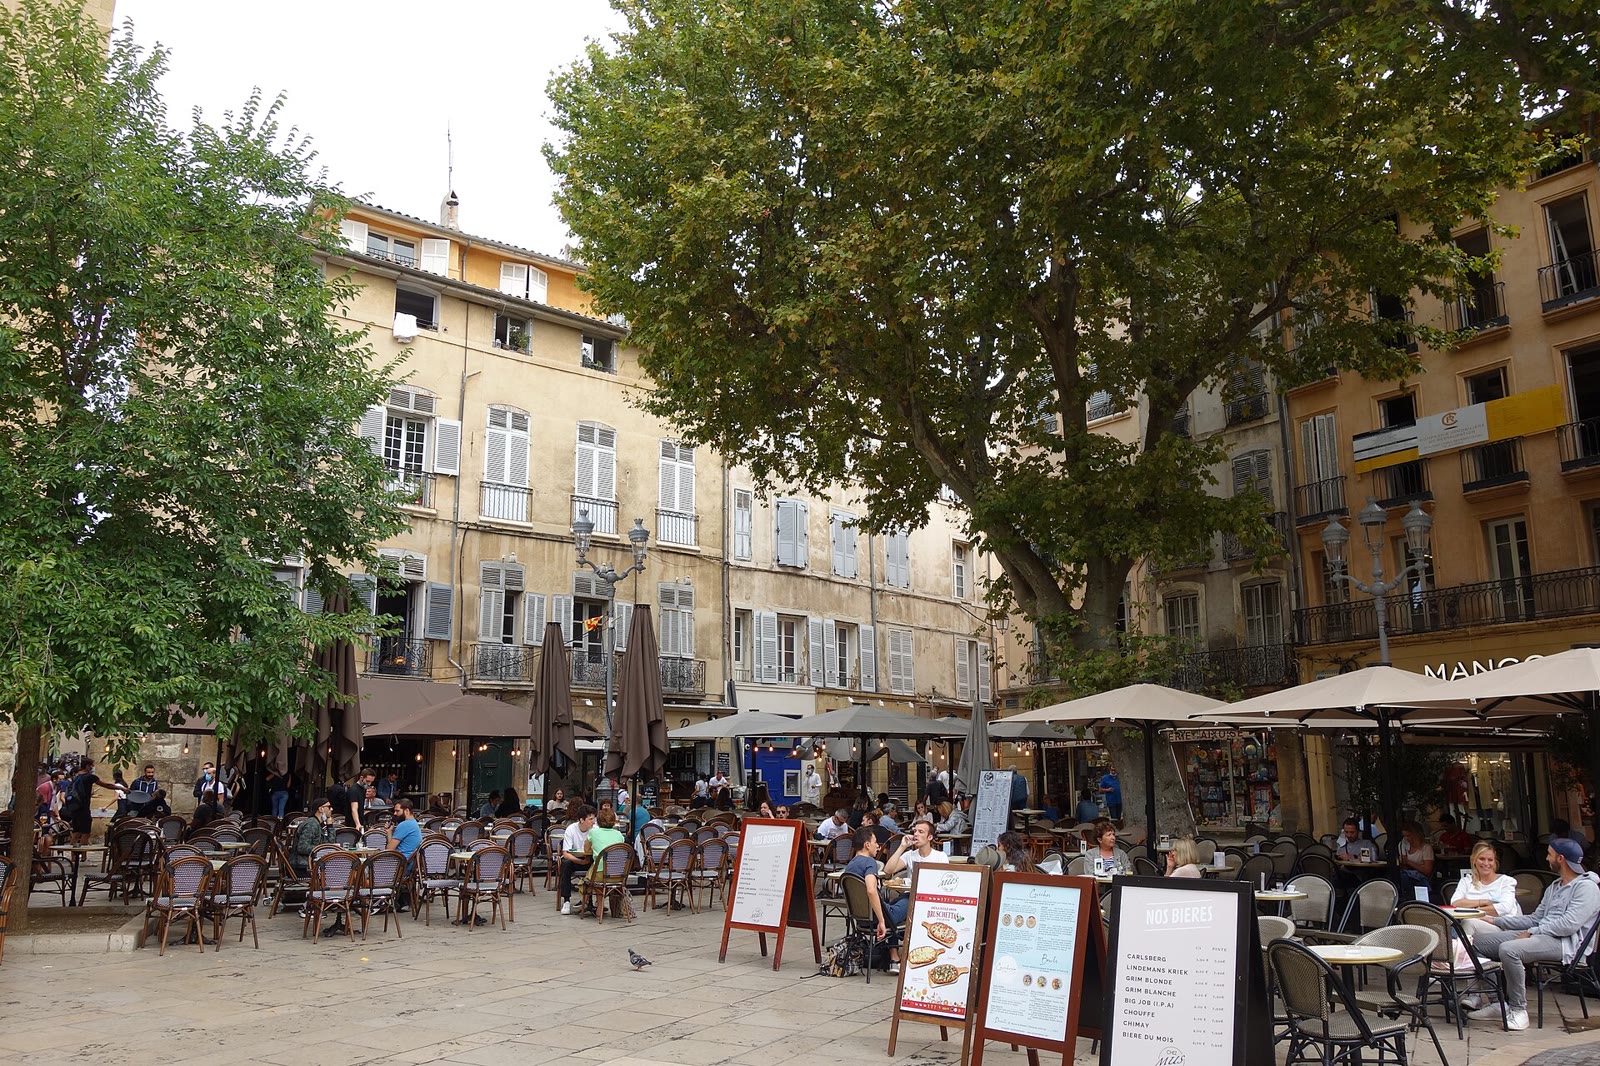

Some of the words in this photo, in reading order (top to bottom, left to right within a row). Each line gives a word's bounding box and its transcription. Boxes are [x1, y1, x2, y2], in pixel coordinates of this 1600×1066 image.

[1424, 654, 1545, 682] MAN
[1020, 740, 1068, 749] PAPTERIE
[1146, 908, 1169, 926] NOS
[1171, 905, 1213, 924] BIERES
[1127, 953, 1167, 962] CARLSBERG
[1126, 965, 1166, 974] LINDEMANS
[1168, 968, 1189, 976] KRIEK
[1125, 975, 1143, 983] GRIM
[1145, 977, 1173, 985] BLONDE
[1125, 986, 1142, 994] GRIM
[1144, 988, 1176, 997] BLANCHE
[1124, 997, 1136, 1005] BIG
[1123, 1009, 1156, 1018] CHOUFFE
[1123, 1020, 1150, 1029] CHIMAY
[1122, 1031, 1142, 1040] BIERE
